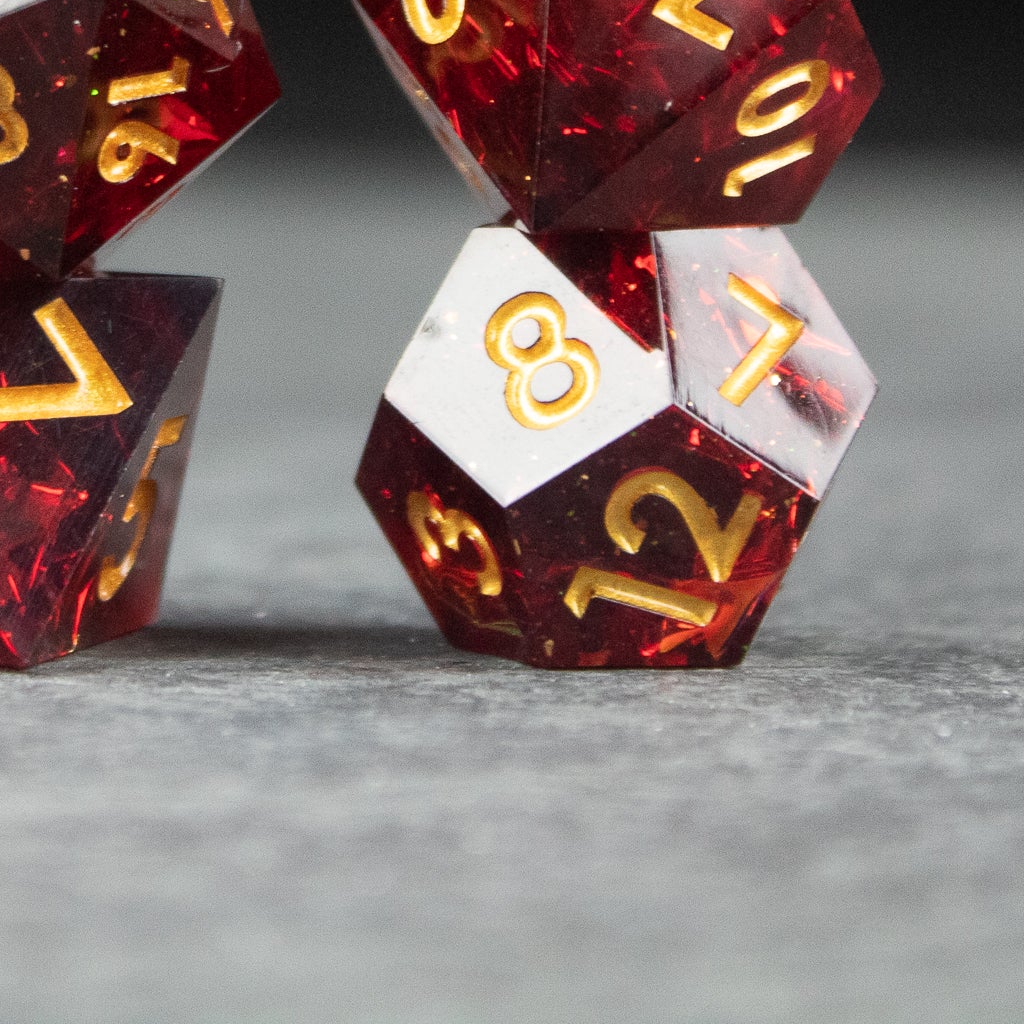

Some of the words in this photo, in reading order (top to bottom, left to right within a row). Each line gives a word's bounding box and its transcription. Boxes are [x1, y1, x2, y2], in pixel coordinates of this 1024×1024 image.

[723, 59, 829, 197] 10
[484, 291, 601, 430] 8
[717, 272, 804, 407] 7
[406, 490, 503, 597] 3
[563, 467, 763, 627] 12
